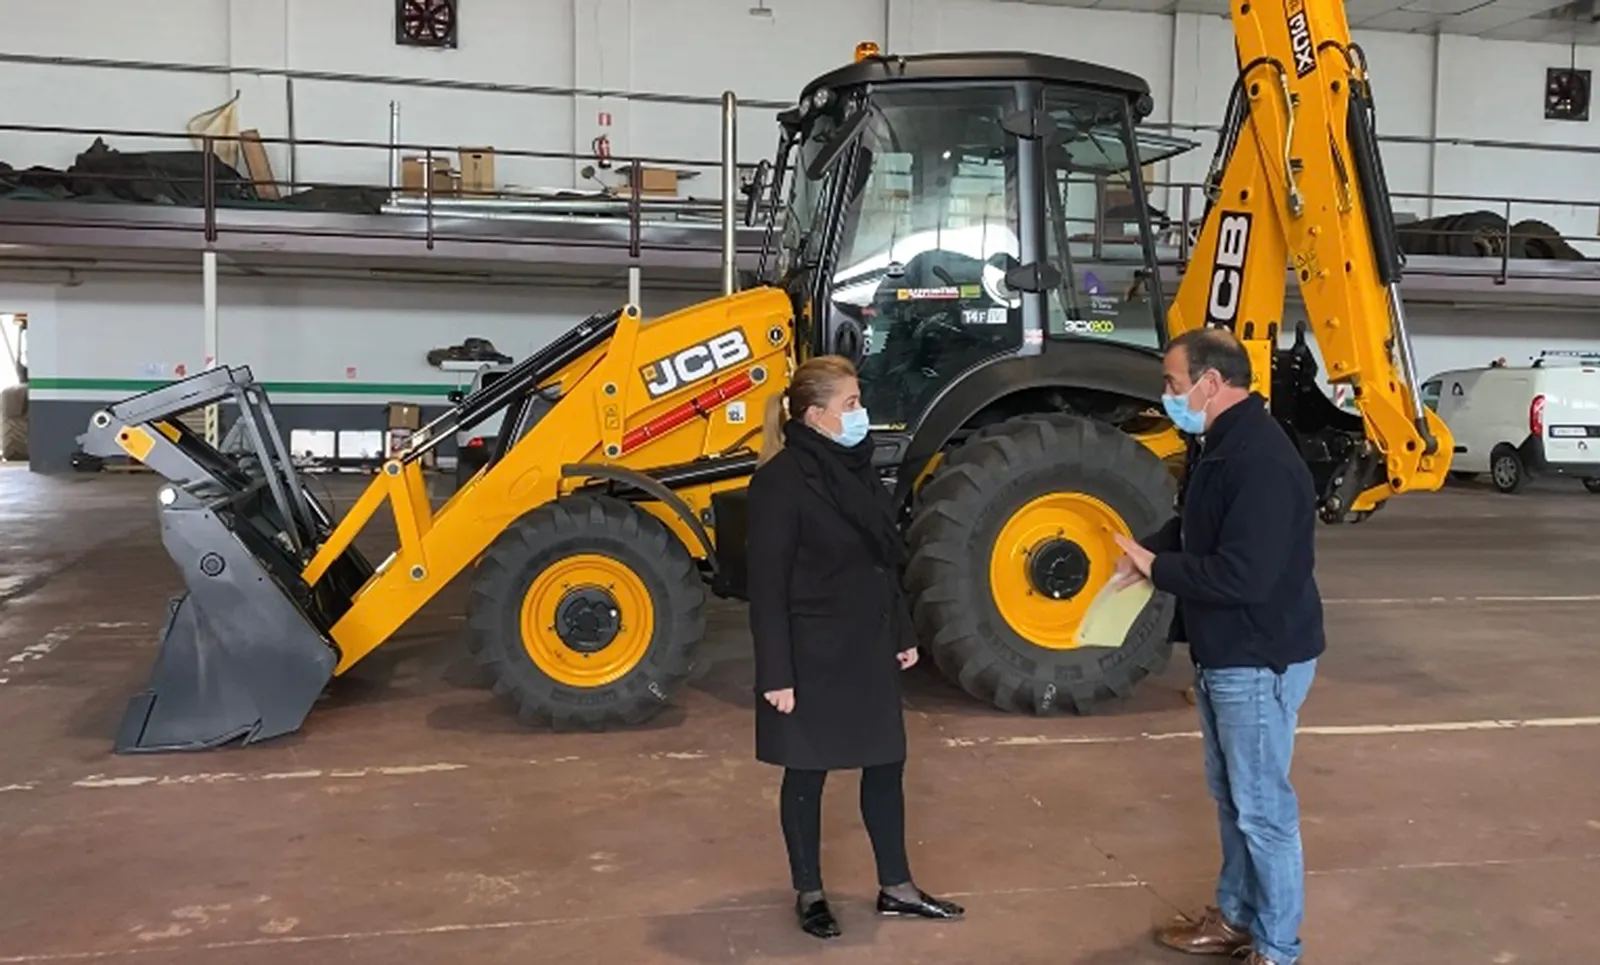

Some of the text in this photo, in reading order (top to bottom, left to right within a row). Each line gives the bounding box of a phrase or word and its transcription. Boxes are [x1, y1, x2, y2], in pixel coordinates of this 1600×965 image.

[1288, 13, 1314, 71] 3CX
[1208, 216, 1248, 331] CB
[648, 331, 750, 395] JCB
